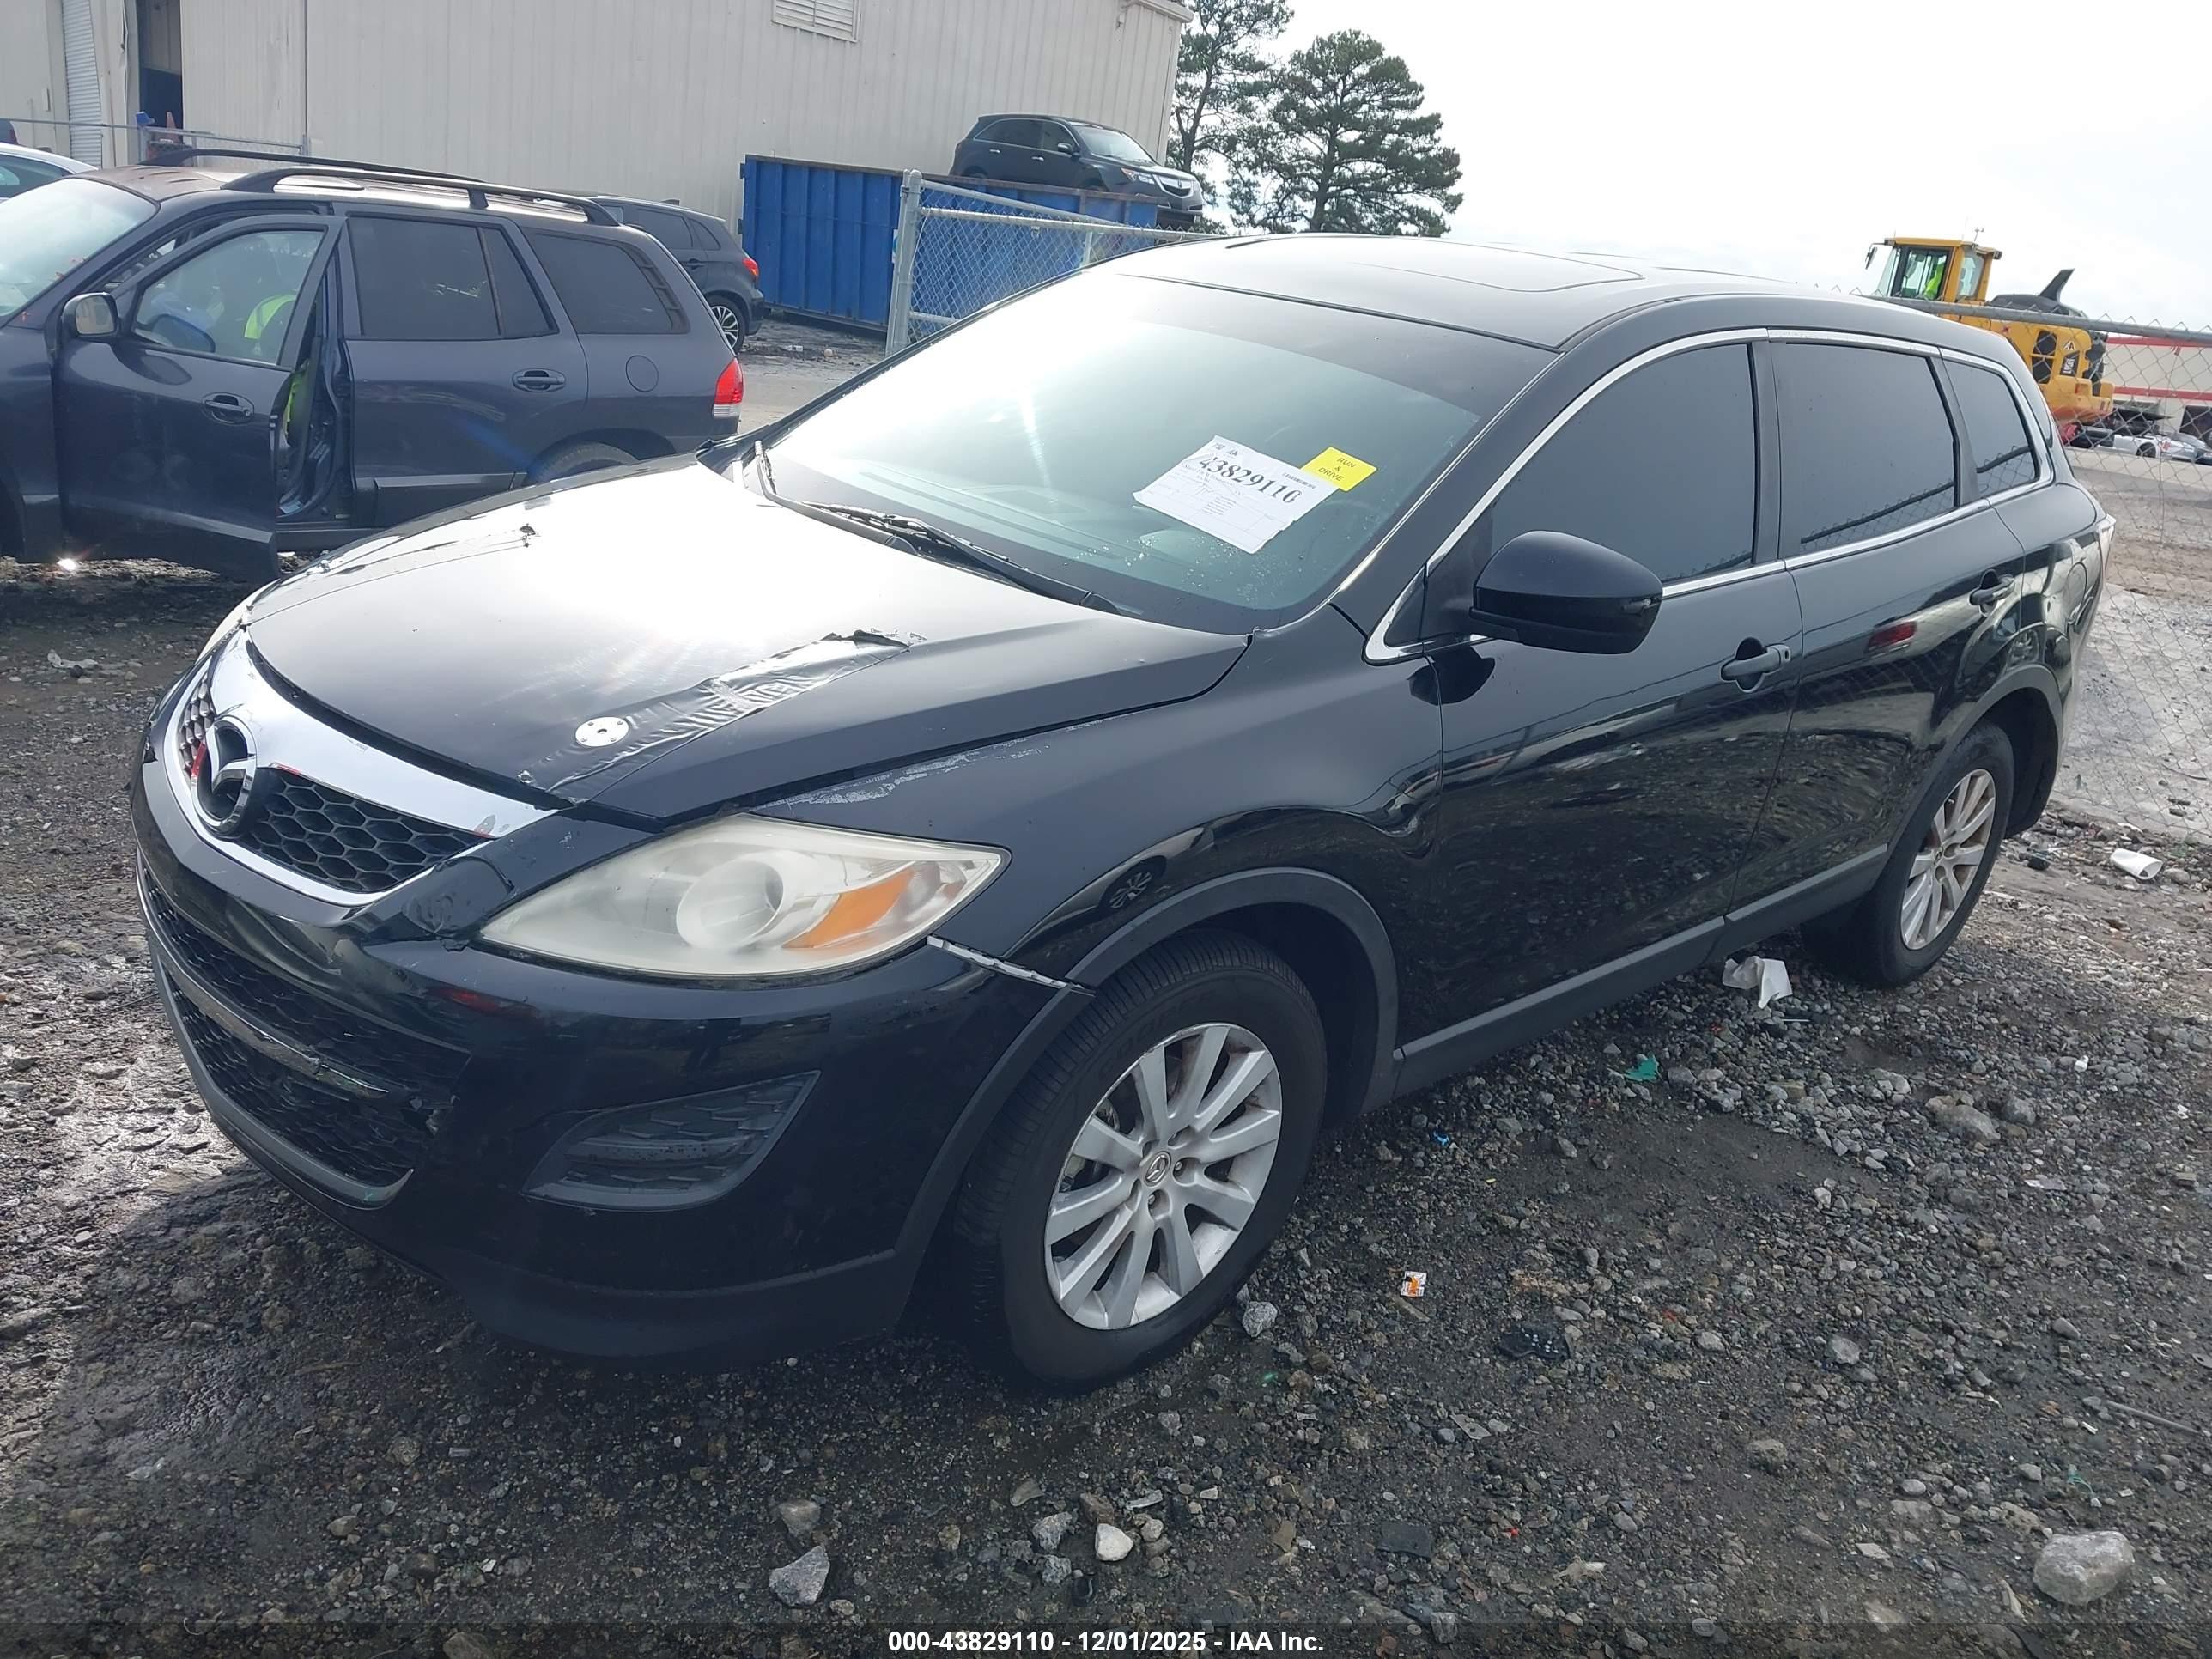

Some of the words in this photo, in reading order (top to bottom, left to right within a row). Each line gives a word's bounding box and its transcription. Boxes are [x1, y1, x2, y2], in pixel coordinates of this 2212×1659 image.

[1336, 457, 1357, 468] RUN
[1200, 456, 1303, 504] 43829110
[1318, 467, 1345, 482] DRIVE
